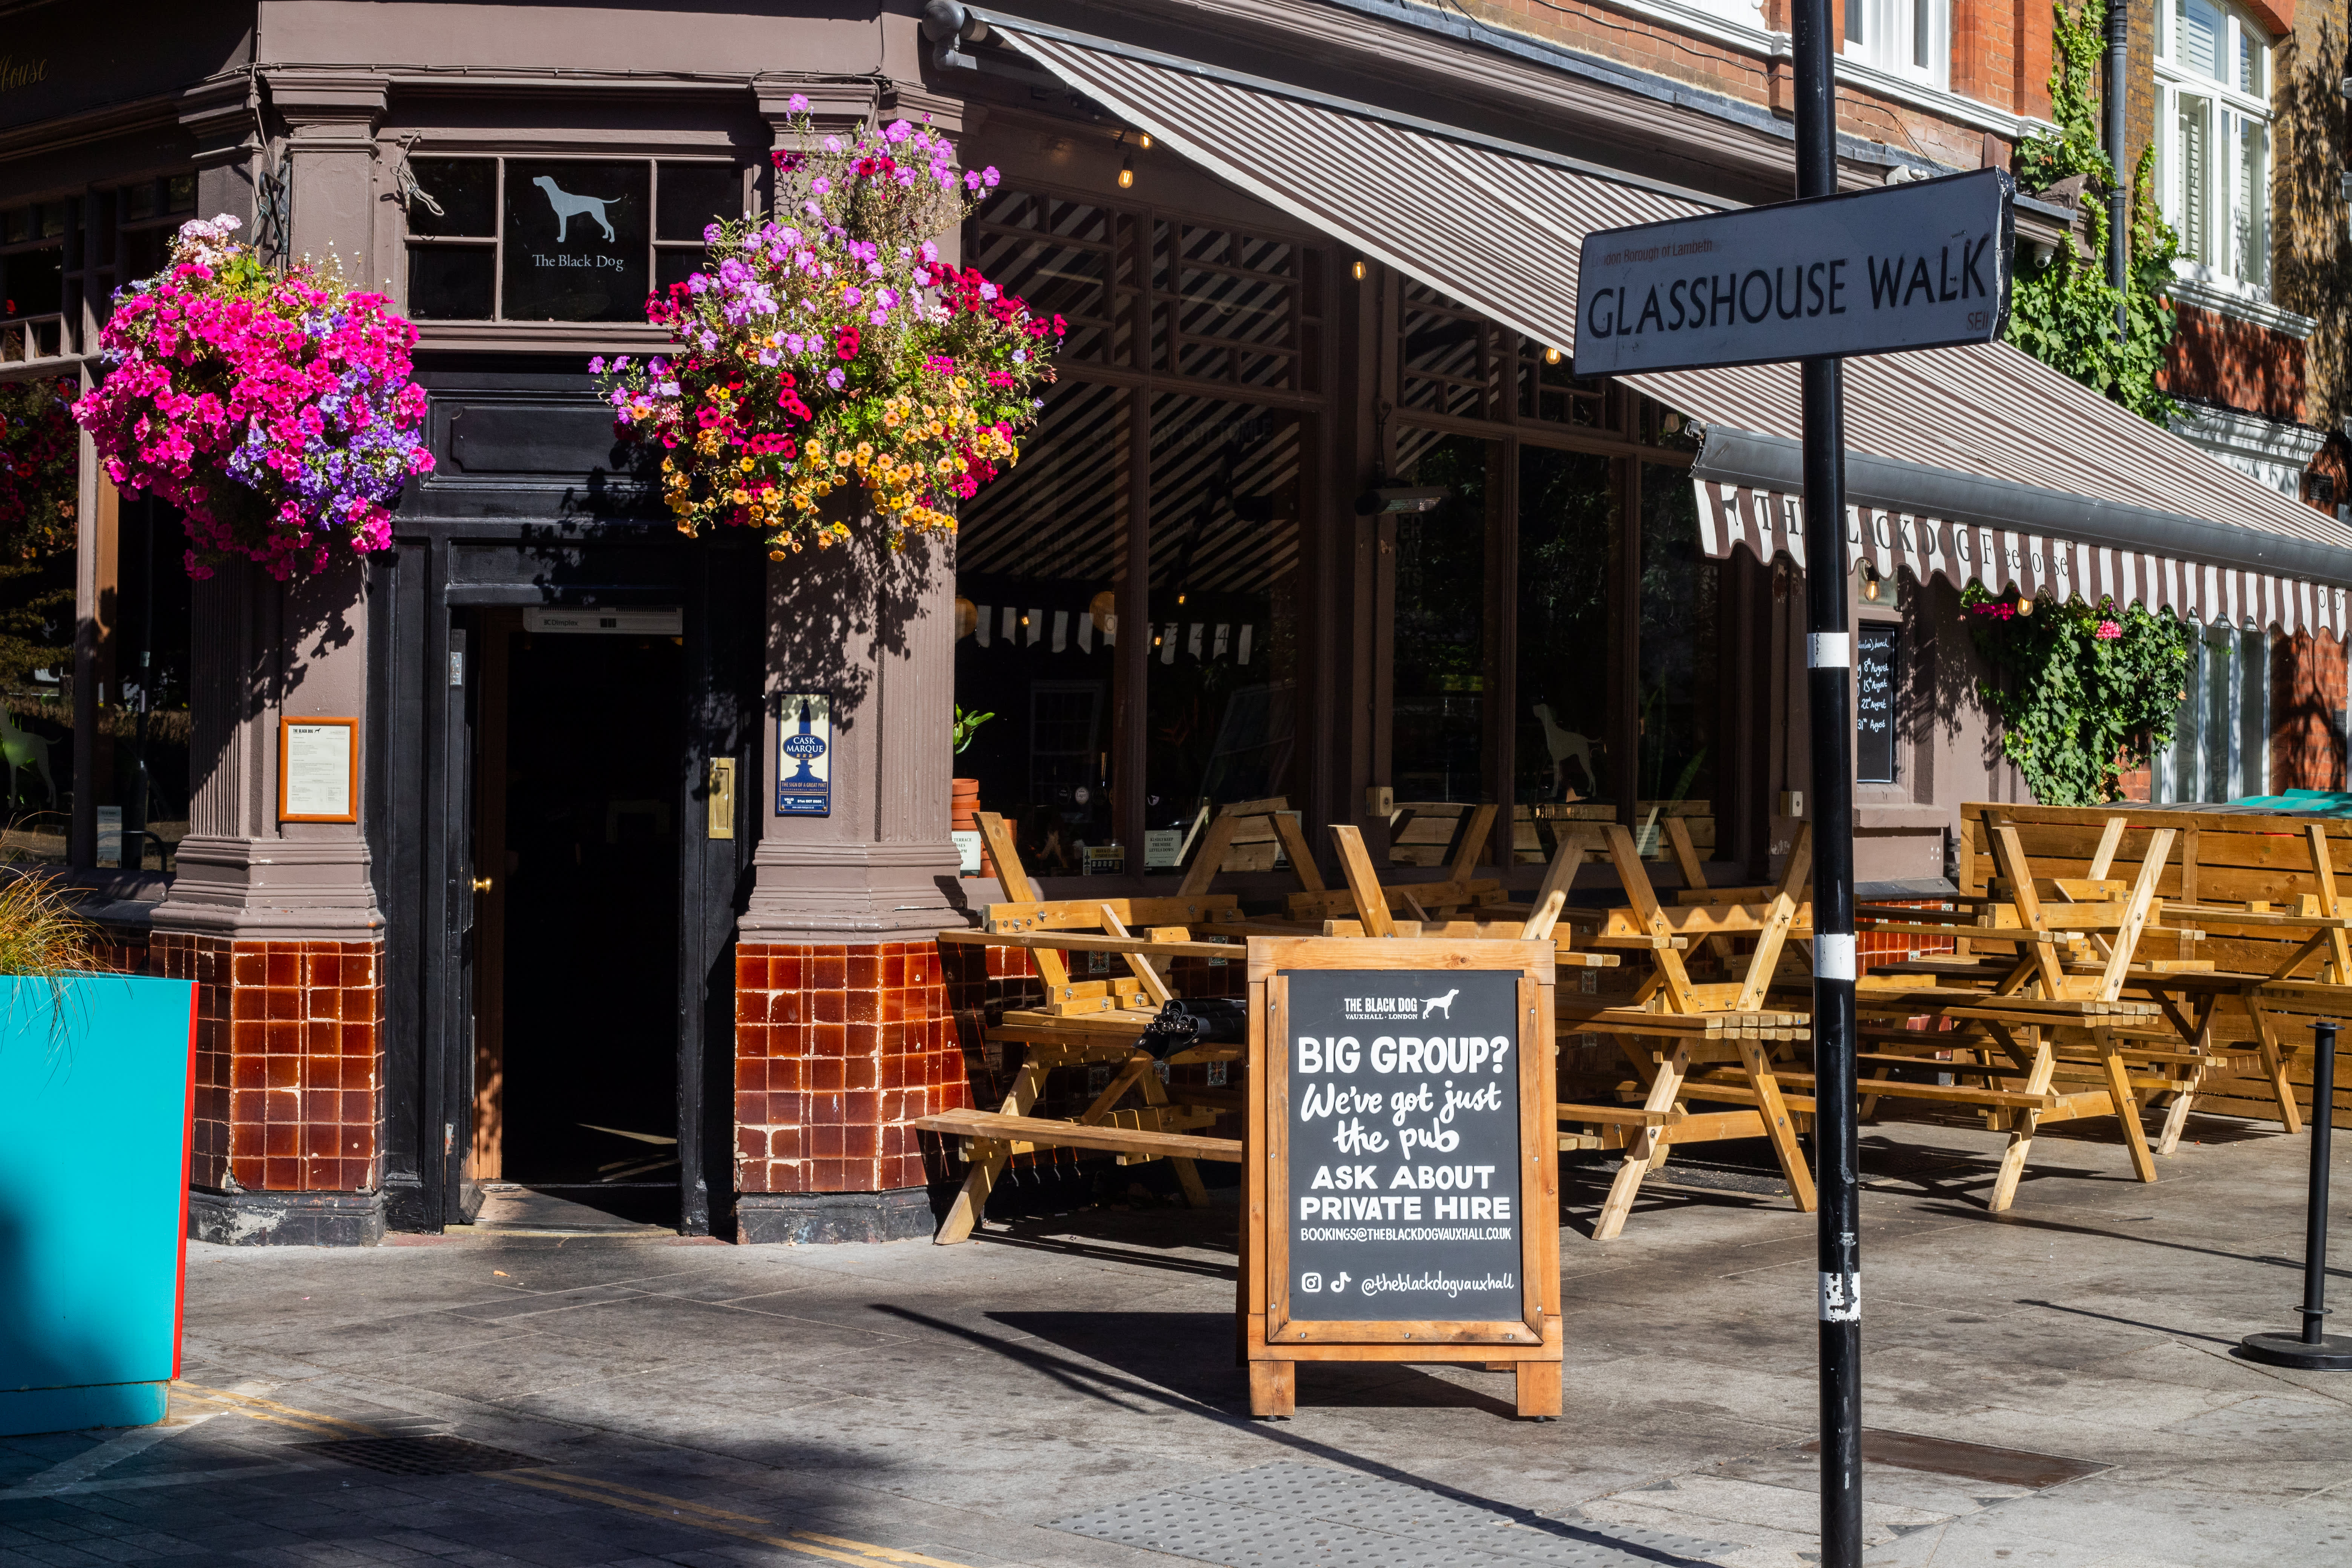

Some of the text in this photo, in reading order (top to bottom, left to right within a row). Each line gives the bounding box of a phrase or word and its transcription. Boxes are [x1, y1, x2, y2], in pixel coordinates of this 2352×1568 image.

[1624, 246, 1658, 263] Borough
[1661, 245, 1671, 257] of
[1672, 238, 1713, 257] Lambeth
[532, 254, 624, 272] The Black Dog
[1588, 233, 1992, 339] GLASSHOUSE WALK
[1754, 494, 1804, 536] TH
[1846, 510, 1914, 553] LACK
[1917, 522, 1972, 562] DOG
[1874, 638, 1889, 649] brunch
[1871, 662, 1889, 677] August
[1872, 678, 1888, 693] August
[1871, 698, 1886, 711] August
[1870, 719, 1885, 733] August
[786, 745, 823, 753] MARQUE
[1344, 998, 1418, 1012] THE BLACK DOG
[1298, 1036, 1509, 1073] BIG GROUP?
[1301, 1080, 1501, 1127] We've got just
[1333, 1117, 1460, 1161] the pub
[1311, 1165, 1495, 1190] ASK ABOUT
[1300, 1196, 1511, 1220] PRIVATE HIRE
[1301, 1228, 1511, 1242] BOOKINGS@THEBLACKDOGVAUXHALL.CO.UK
[1361, 1270, 1514, 1298] @theblackdogvauxhall
